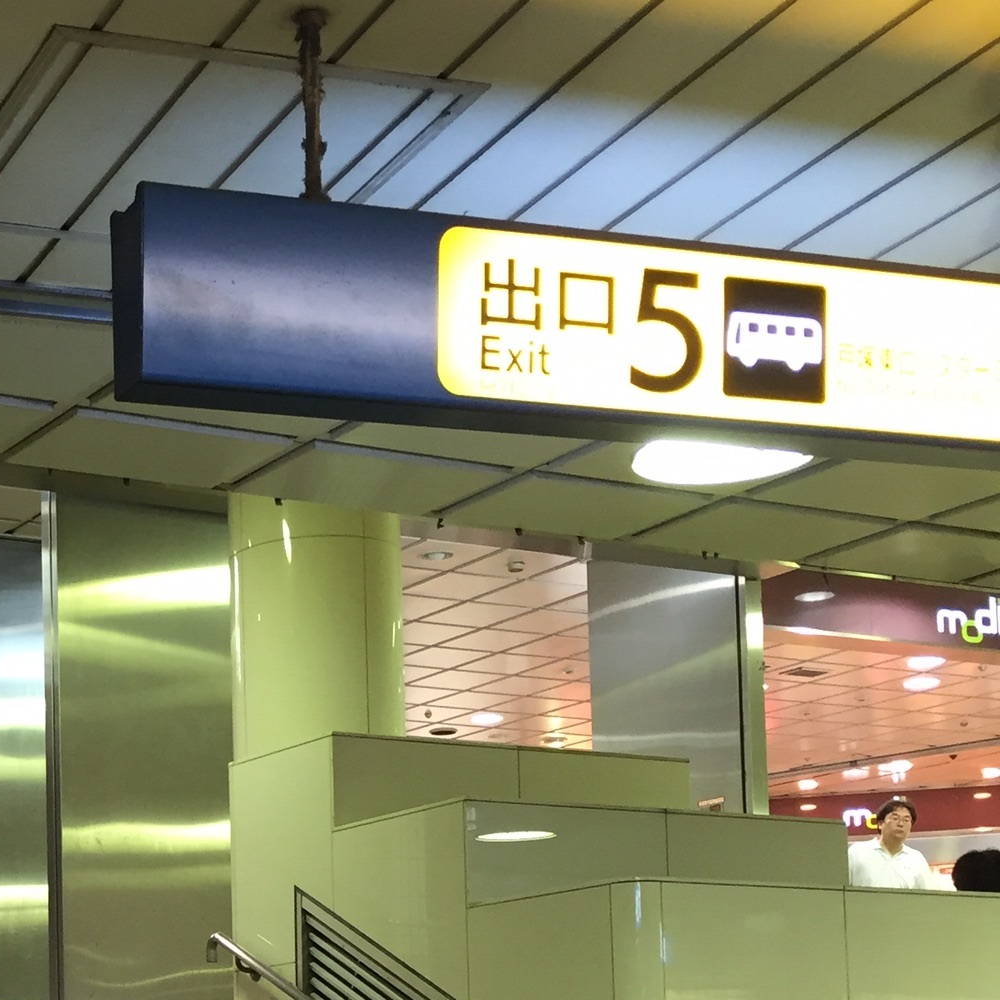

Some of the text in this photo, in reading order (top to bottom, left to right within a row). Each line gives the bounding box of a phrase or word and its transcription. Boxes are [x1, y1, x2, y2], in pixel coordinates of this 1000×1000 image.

[481, 258, 703, 393] 出口 5
[481, 336, 550, 376] Exit
